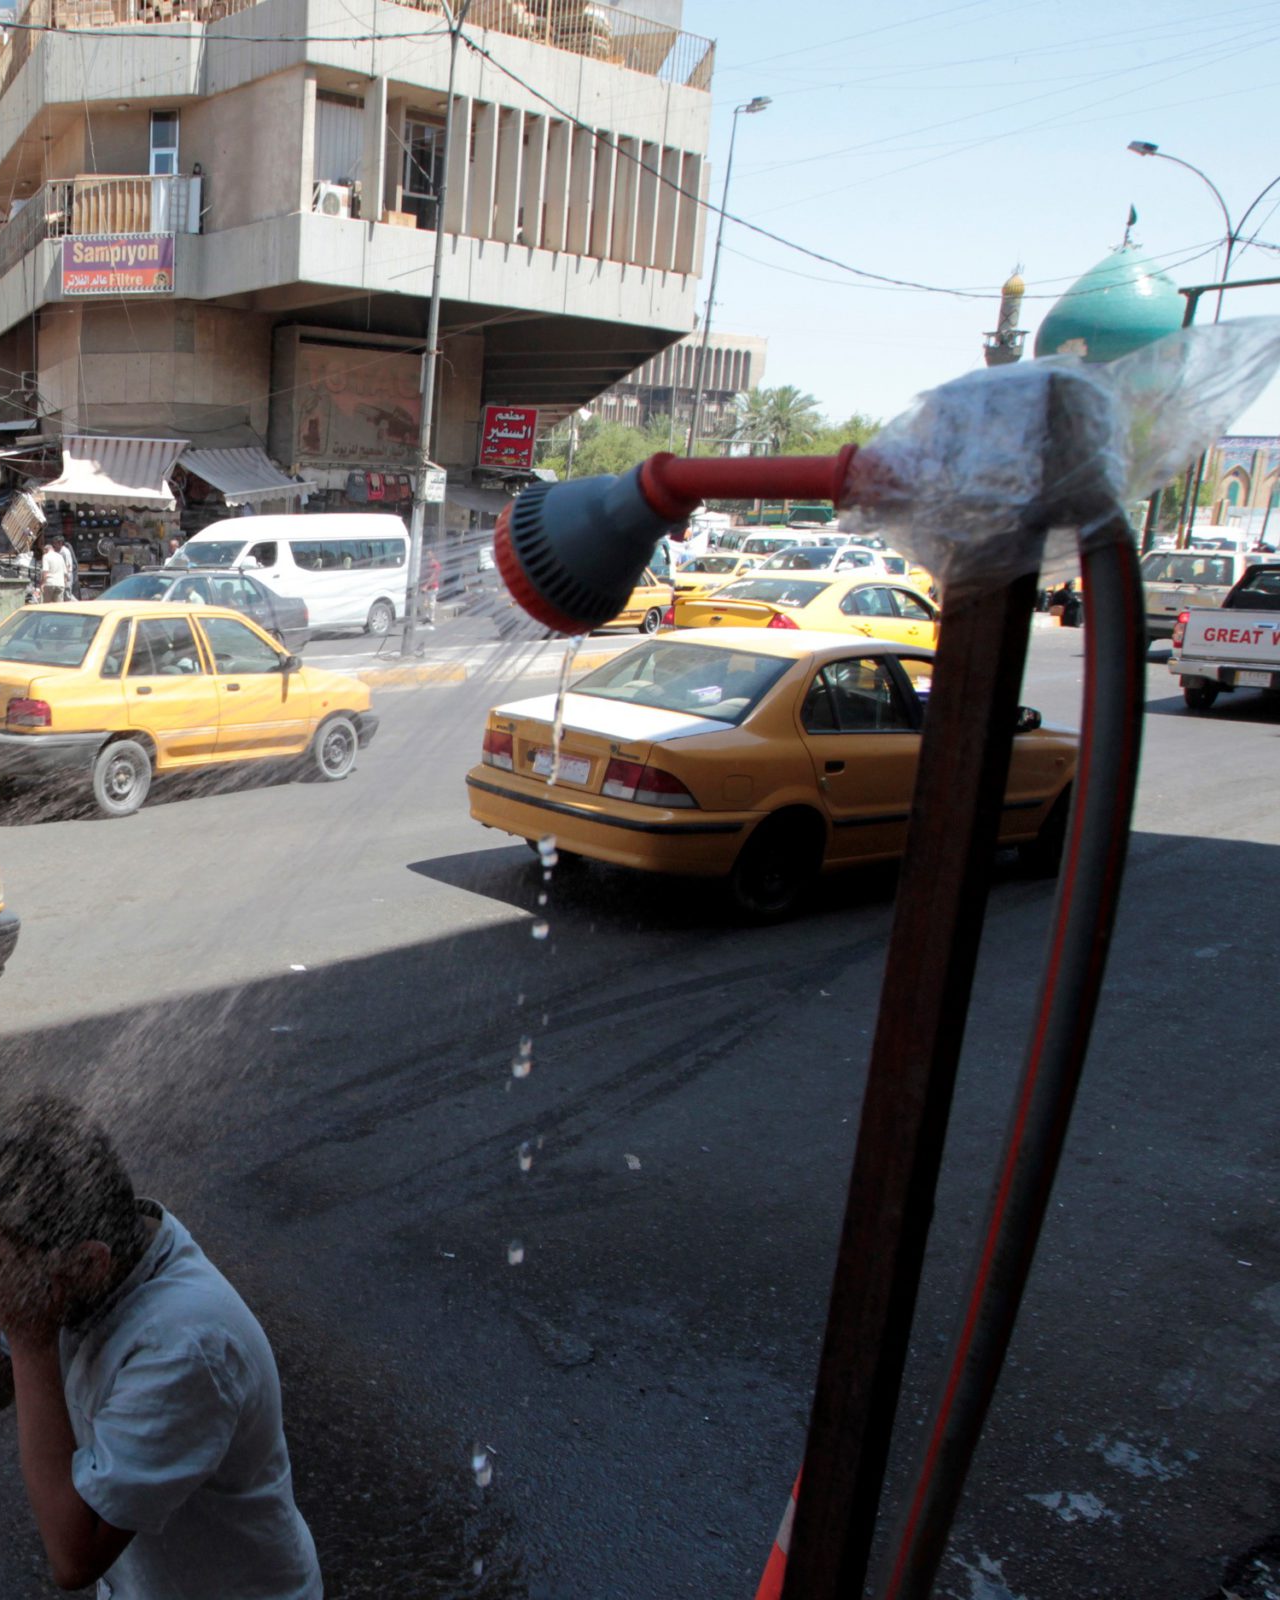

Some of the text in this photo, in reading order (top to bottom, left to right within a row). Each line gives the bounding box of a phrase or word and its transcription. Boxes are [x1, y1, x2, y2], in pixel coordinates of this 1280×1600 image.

[109, 272, 144, 286] Filtre
[495, 410, 526, 422] مطعم
[485, 422, 532, 443] السفير
[1203, 627, 1264, 645] GREAT
